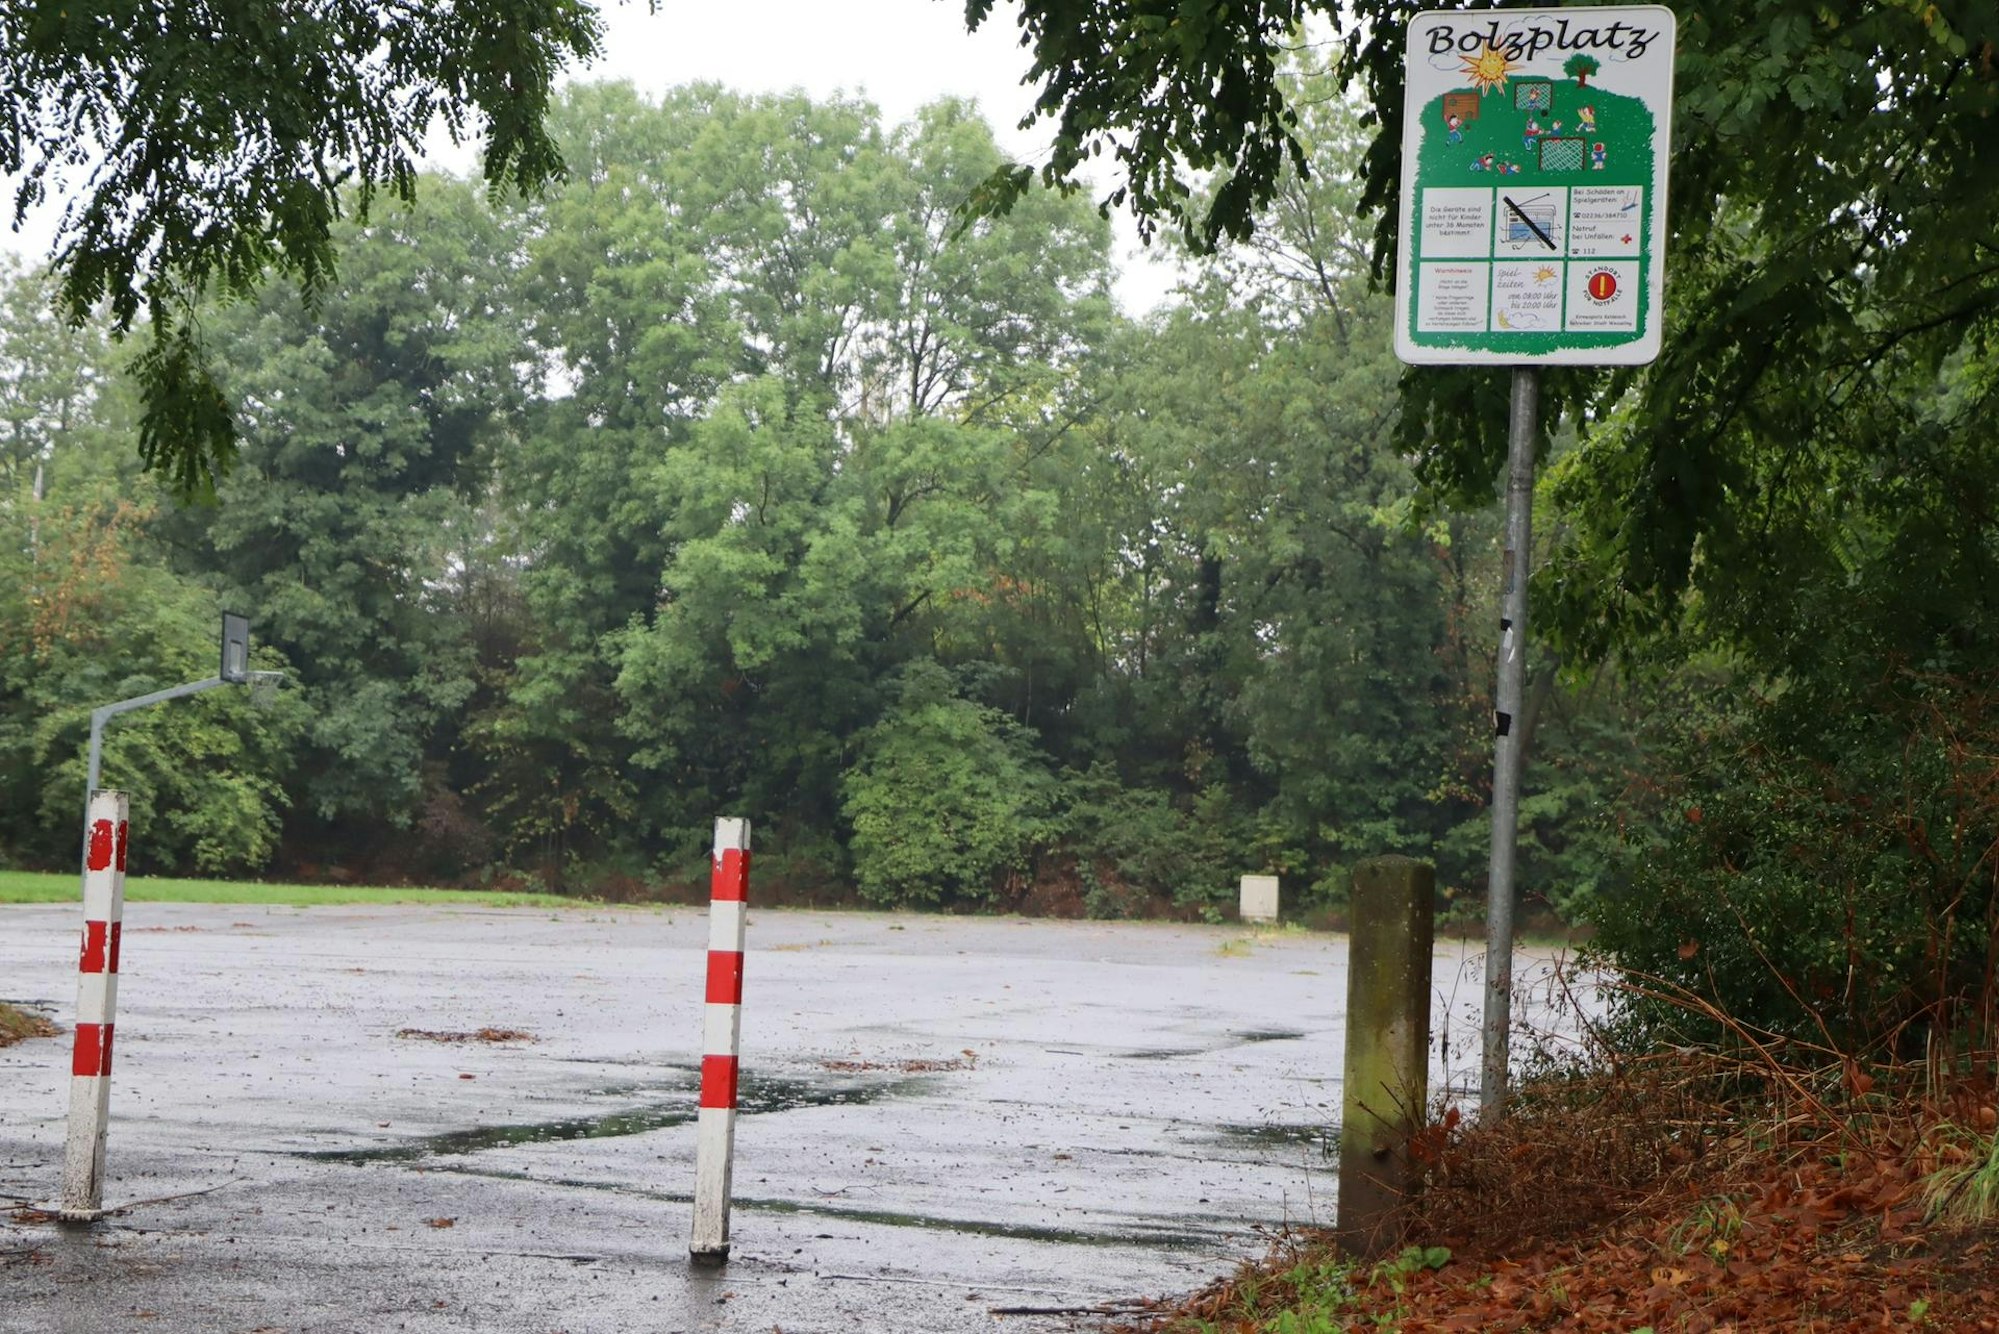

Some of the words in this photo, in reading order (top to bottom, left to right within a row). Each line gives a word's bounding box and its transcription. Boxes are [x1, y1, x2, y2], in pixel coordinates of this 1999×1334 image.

[1425, 18, 1660, 62] Bolzplatz
[1585, 265, 1622, 280] STANDORT
[1543, 291, 1558, 300] Uhr
[1542, 300, 1557, 309] Uhr
